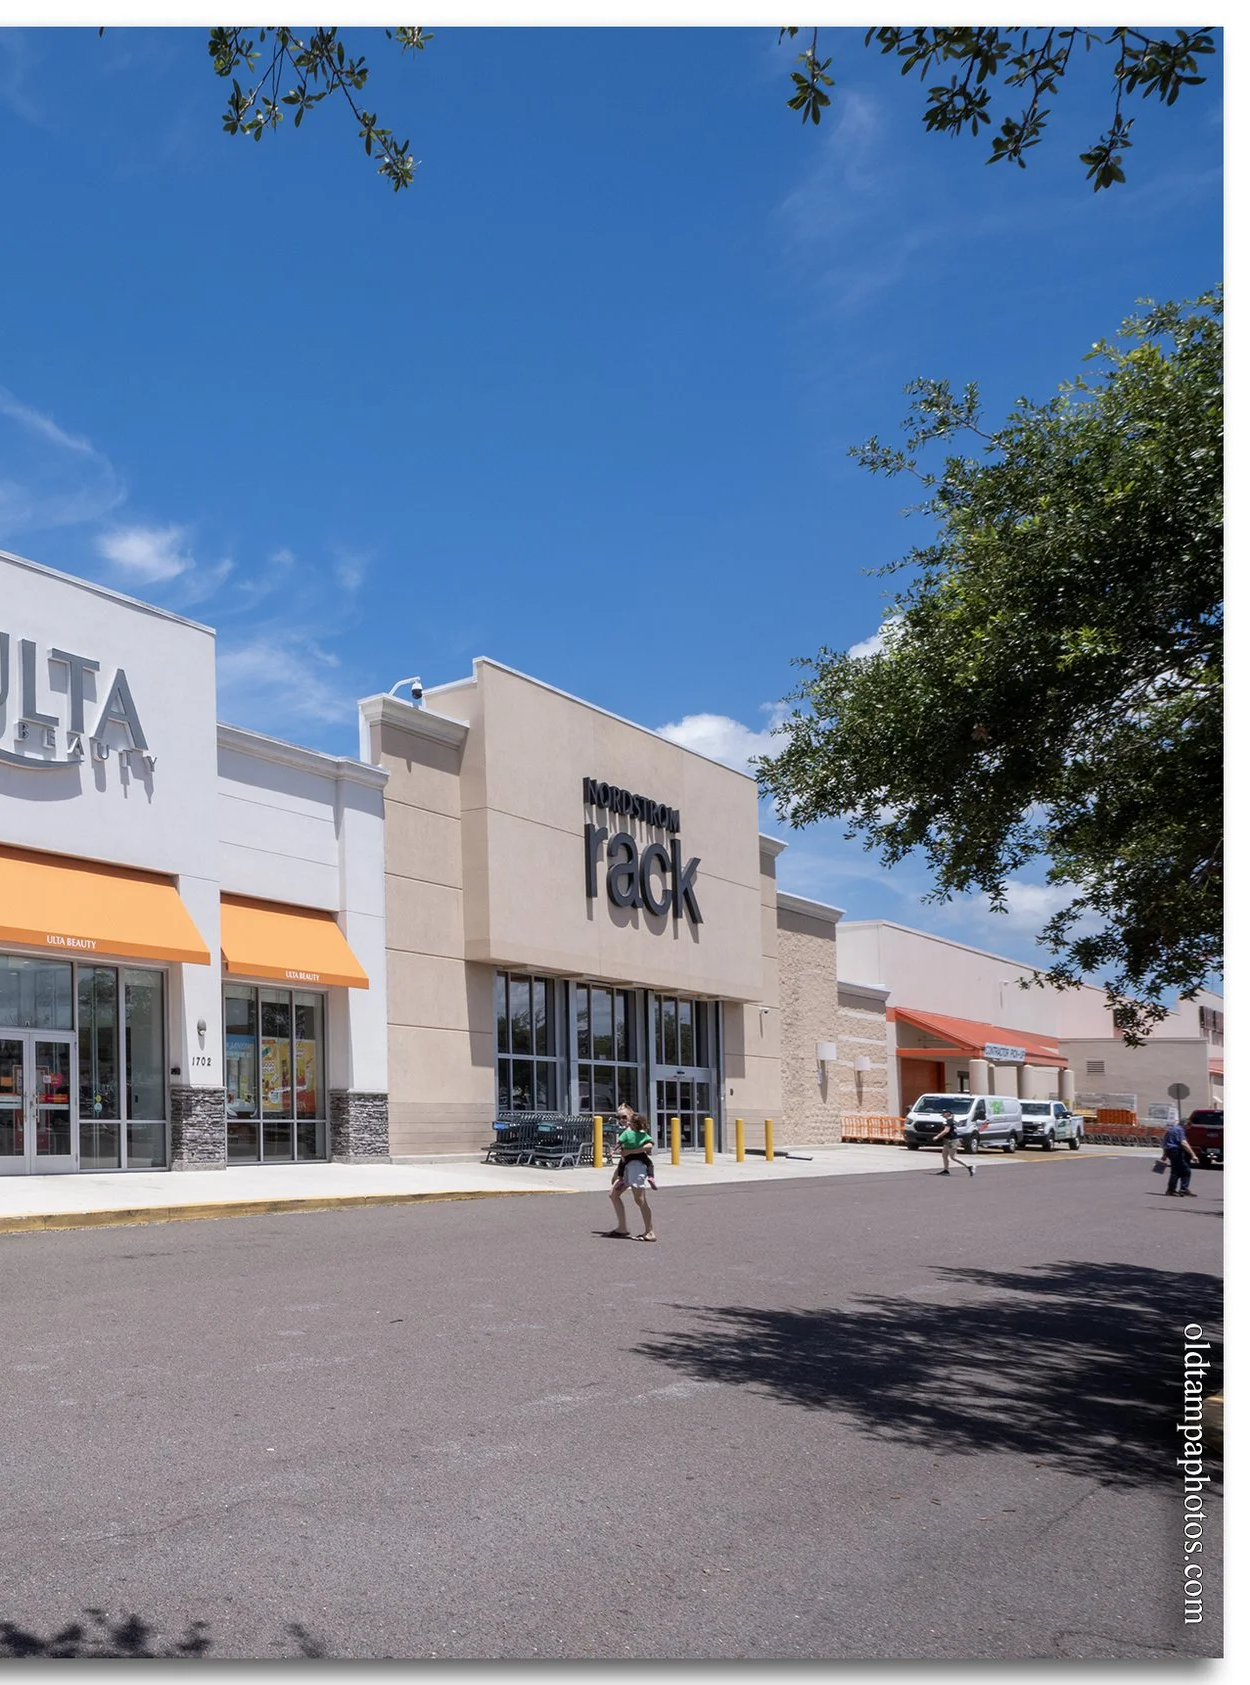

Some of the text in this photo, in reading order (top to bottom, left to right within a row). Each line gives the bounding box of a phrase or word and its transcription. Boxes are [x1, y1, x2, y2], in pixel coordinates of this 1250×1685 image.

[15, 720, 157, 772] BEAUTY
[583, 776, 680, 833] NORDSTROM
[584, 823, 703, 924] rack
[46, 935, 97, 949] ULTA BEAUTY
[285, 970, 319, 982] ULTA BEAUTY
[191, 1056, 211, 1067] 1702
